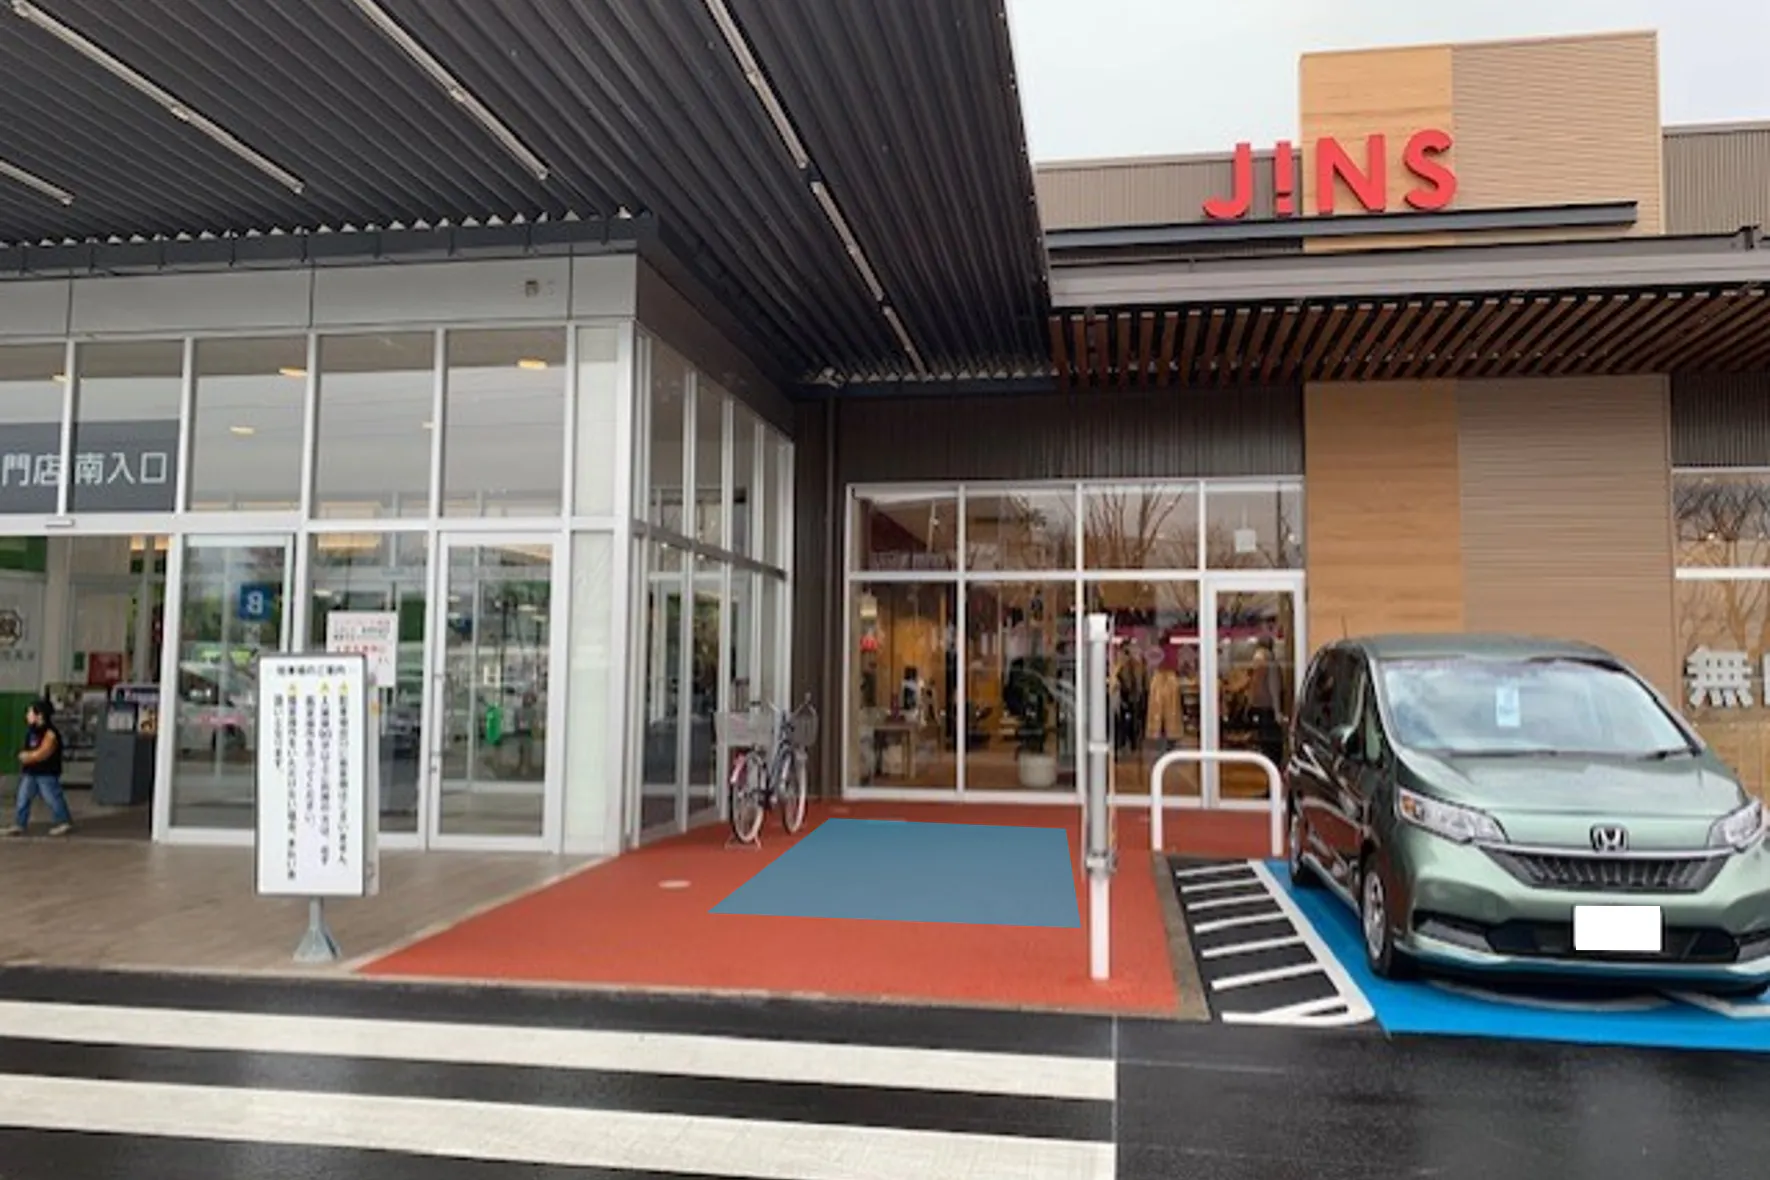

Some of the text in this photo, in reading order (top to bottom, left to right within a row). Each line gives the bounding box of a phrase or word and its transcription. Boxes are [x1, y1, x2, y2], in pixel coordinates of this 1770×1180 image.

[74, 452, 168, 485] 南入口
[1686, 644, 1770, 708] 無
